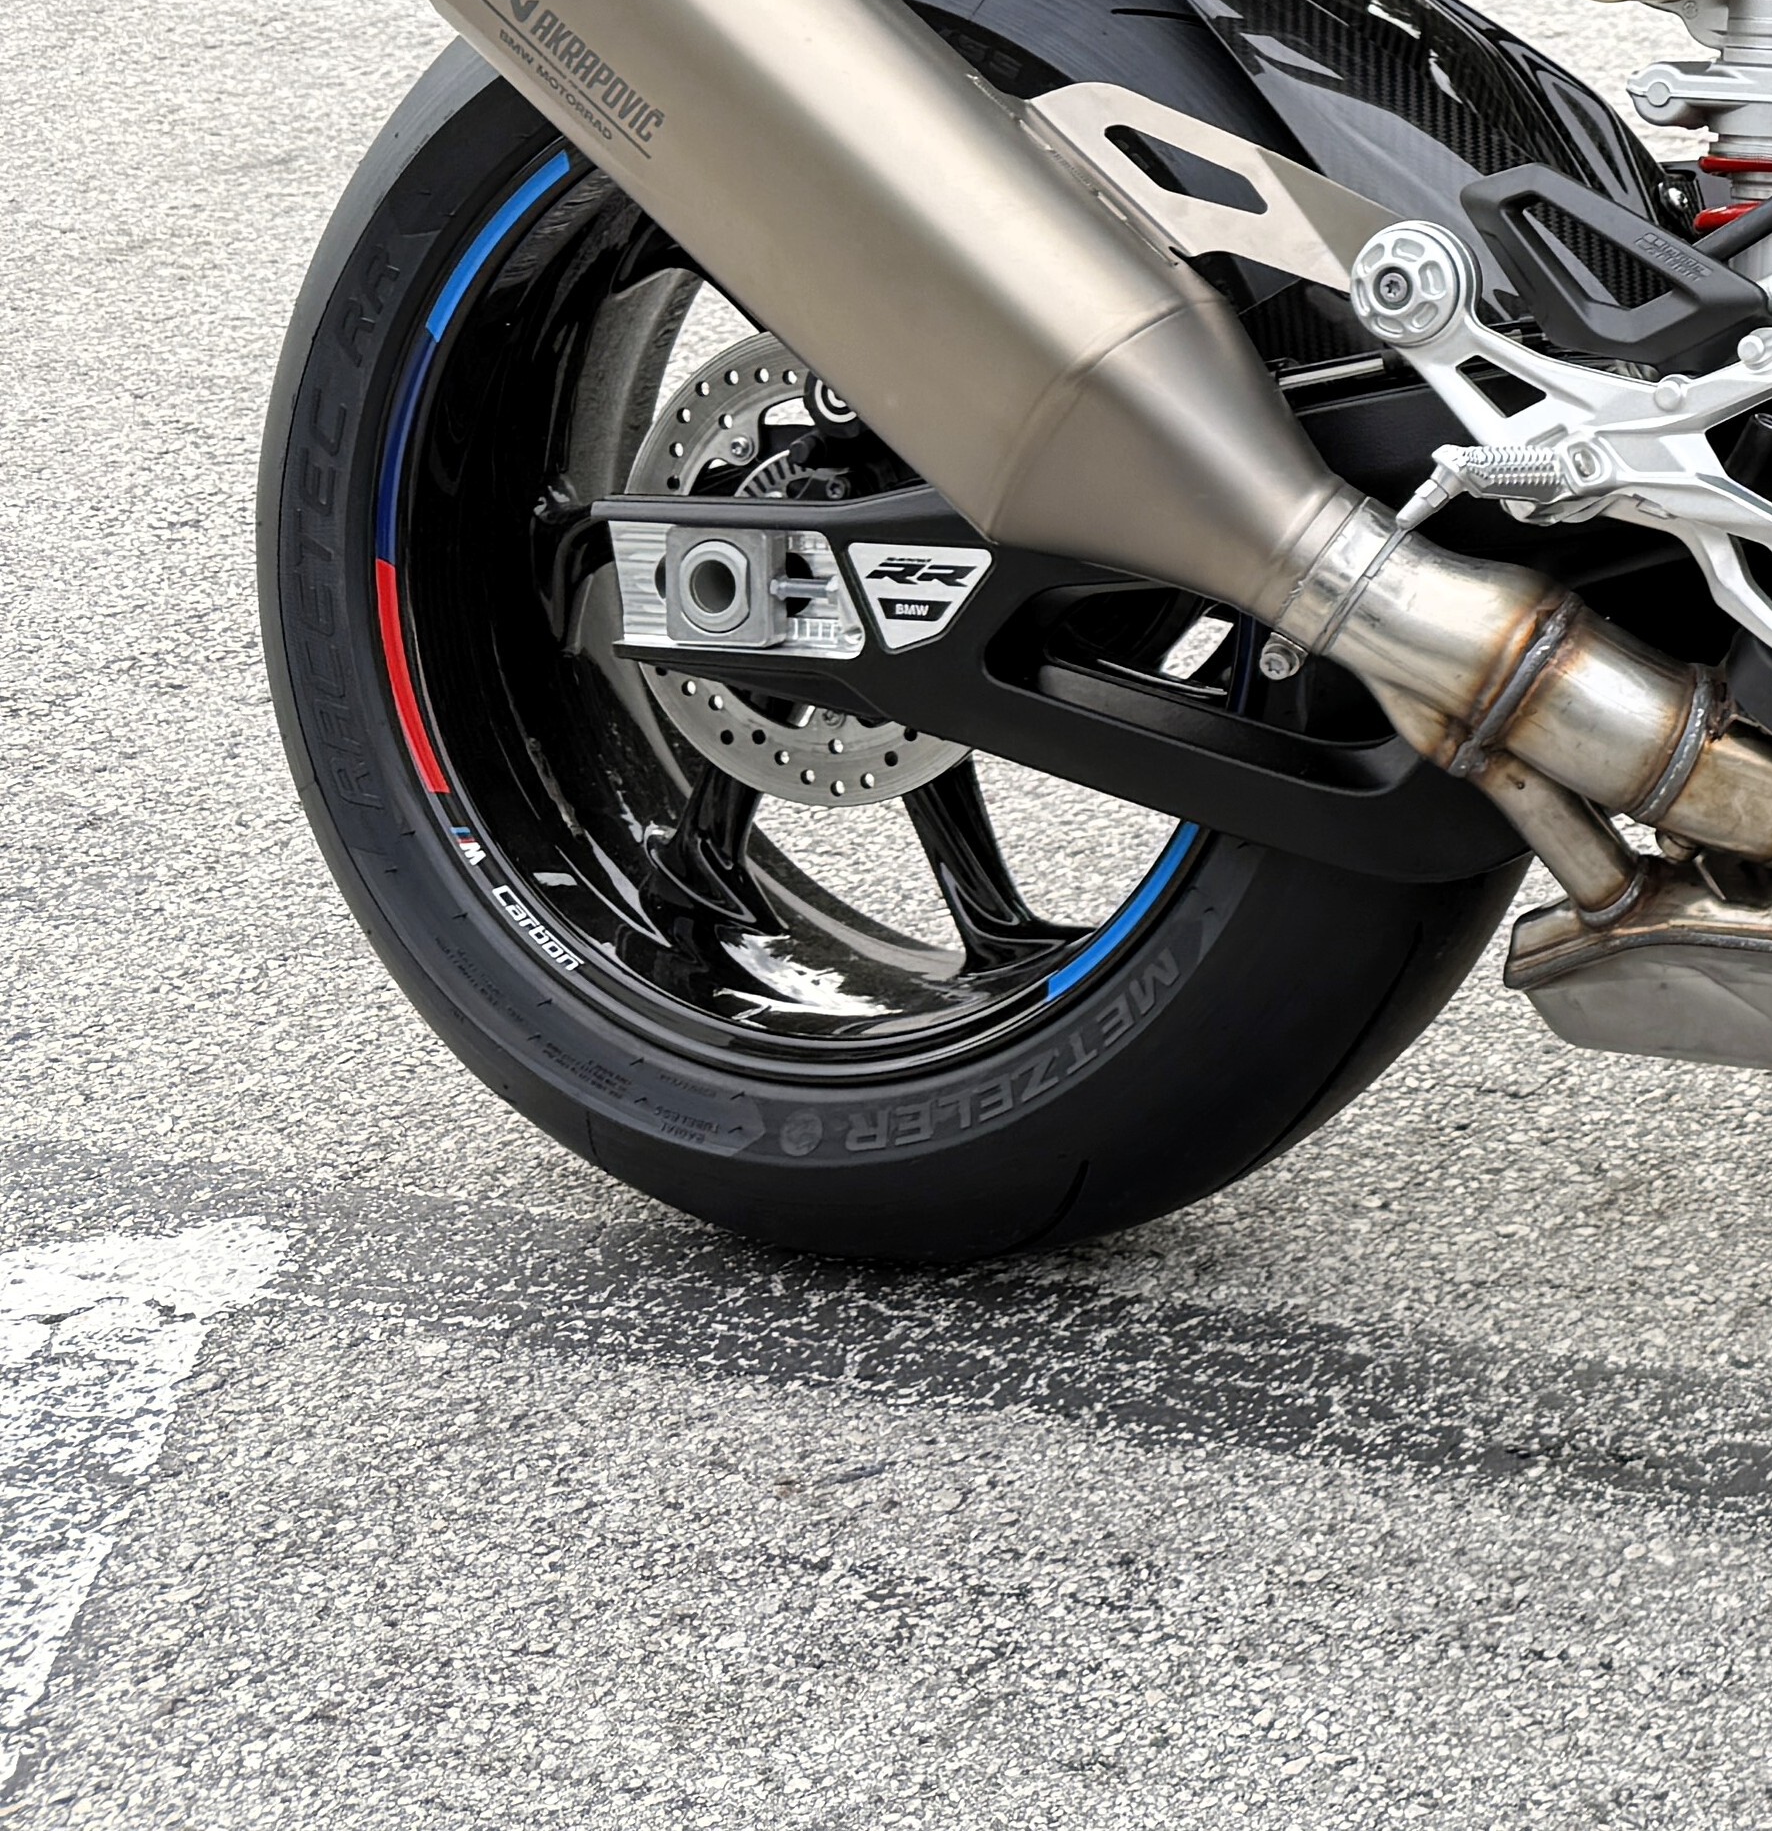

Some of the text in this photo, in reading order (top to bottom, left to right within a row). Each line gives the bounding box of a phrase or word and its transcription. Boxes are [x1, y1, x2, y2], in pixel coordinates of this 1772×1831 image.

[500, 29, 613, 141] BMW MOTORRAD
[530, 9, 666, 142] AKRAPOVIČ
[296, 241, 400, 812] RACETEC RR
[865, 561, 978, 587] RR
[895, 603, 930, 616] BMW
[492, 885, 585, 971] Carbon
[845, 947, 1181, 1152] METZELER
